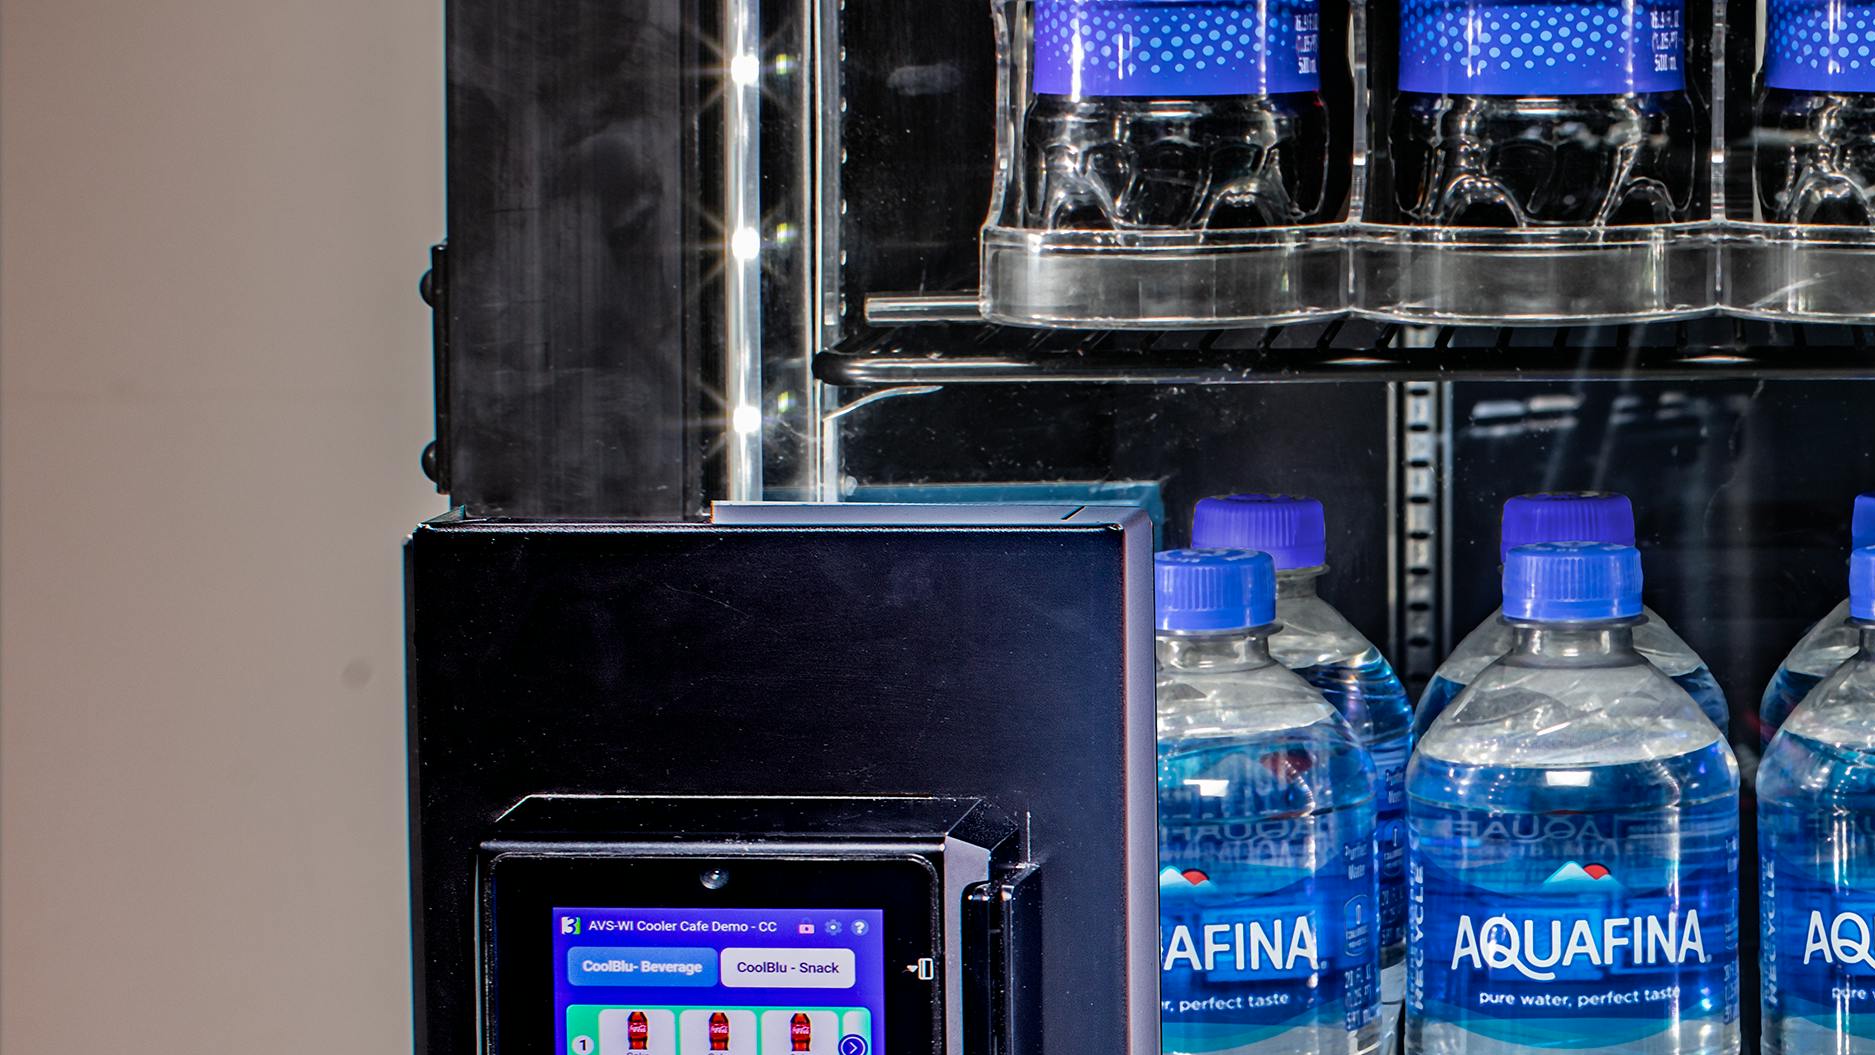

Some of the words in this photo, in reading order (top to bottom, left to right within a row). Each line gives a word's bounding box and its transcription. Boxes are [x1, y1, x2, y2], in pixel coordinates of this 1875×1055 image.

[588, 920, 634, 932] AVS-WI
[637, 920, 677, 932] Cooler
[679, 920, 710, 932] Cafe
[712, 920, 749, 932] Demo
[758, 921, 777, 932] CC
[1451, 909, 1706, 980] AQUAFINA
[640, 960, 703, 976] Beverage
[736, 961, 788, 974] CoolBlu
[799, 961, 840, 974] Snack
[1480, 991, 1515, 1006] pure
[1521, 993, 1572, 1008] water,
[1578, 990, 1639, 1008] perfect
[1645, 986, 1681, 1002] taste
[1832, 987, 1867, 1001] pure
[1179, 995, 1243, 1014] perfect
[1248, 992, 1290, 1008] taste
[579, 1039, 587, 1050] 1
